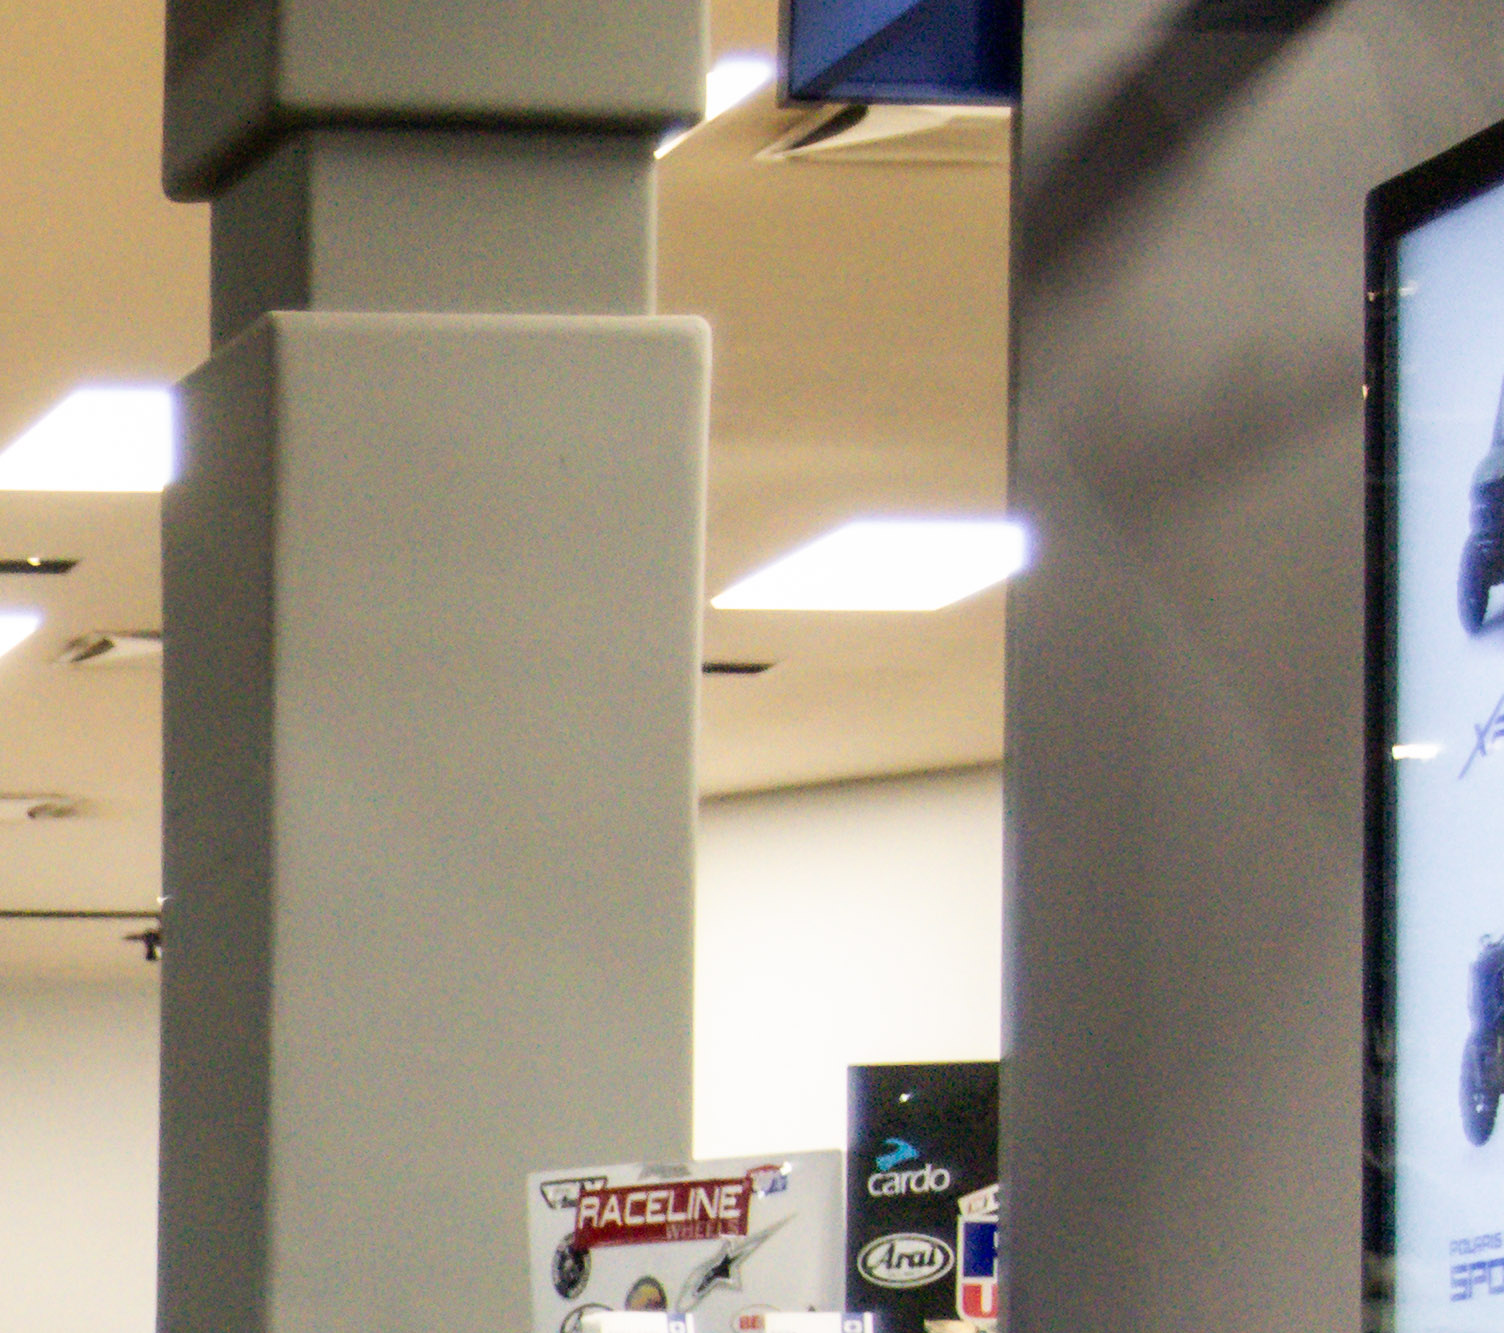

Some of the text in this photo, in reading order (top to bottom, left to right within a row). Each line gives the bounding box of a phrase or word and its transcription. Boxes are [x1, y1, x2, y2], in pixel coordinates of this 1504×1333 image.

[867, 1163, 950, 1197] cardo
[578, 1184, 743, 1229] RACELINE
[870, 1241, 938, 1270] Arai
